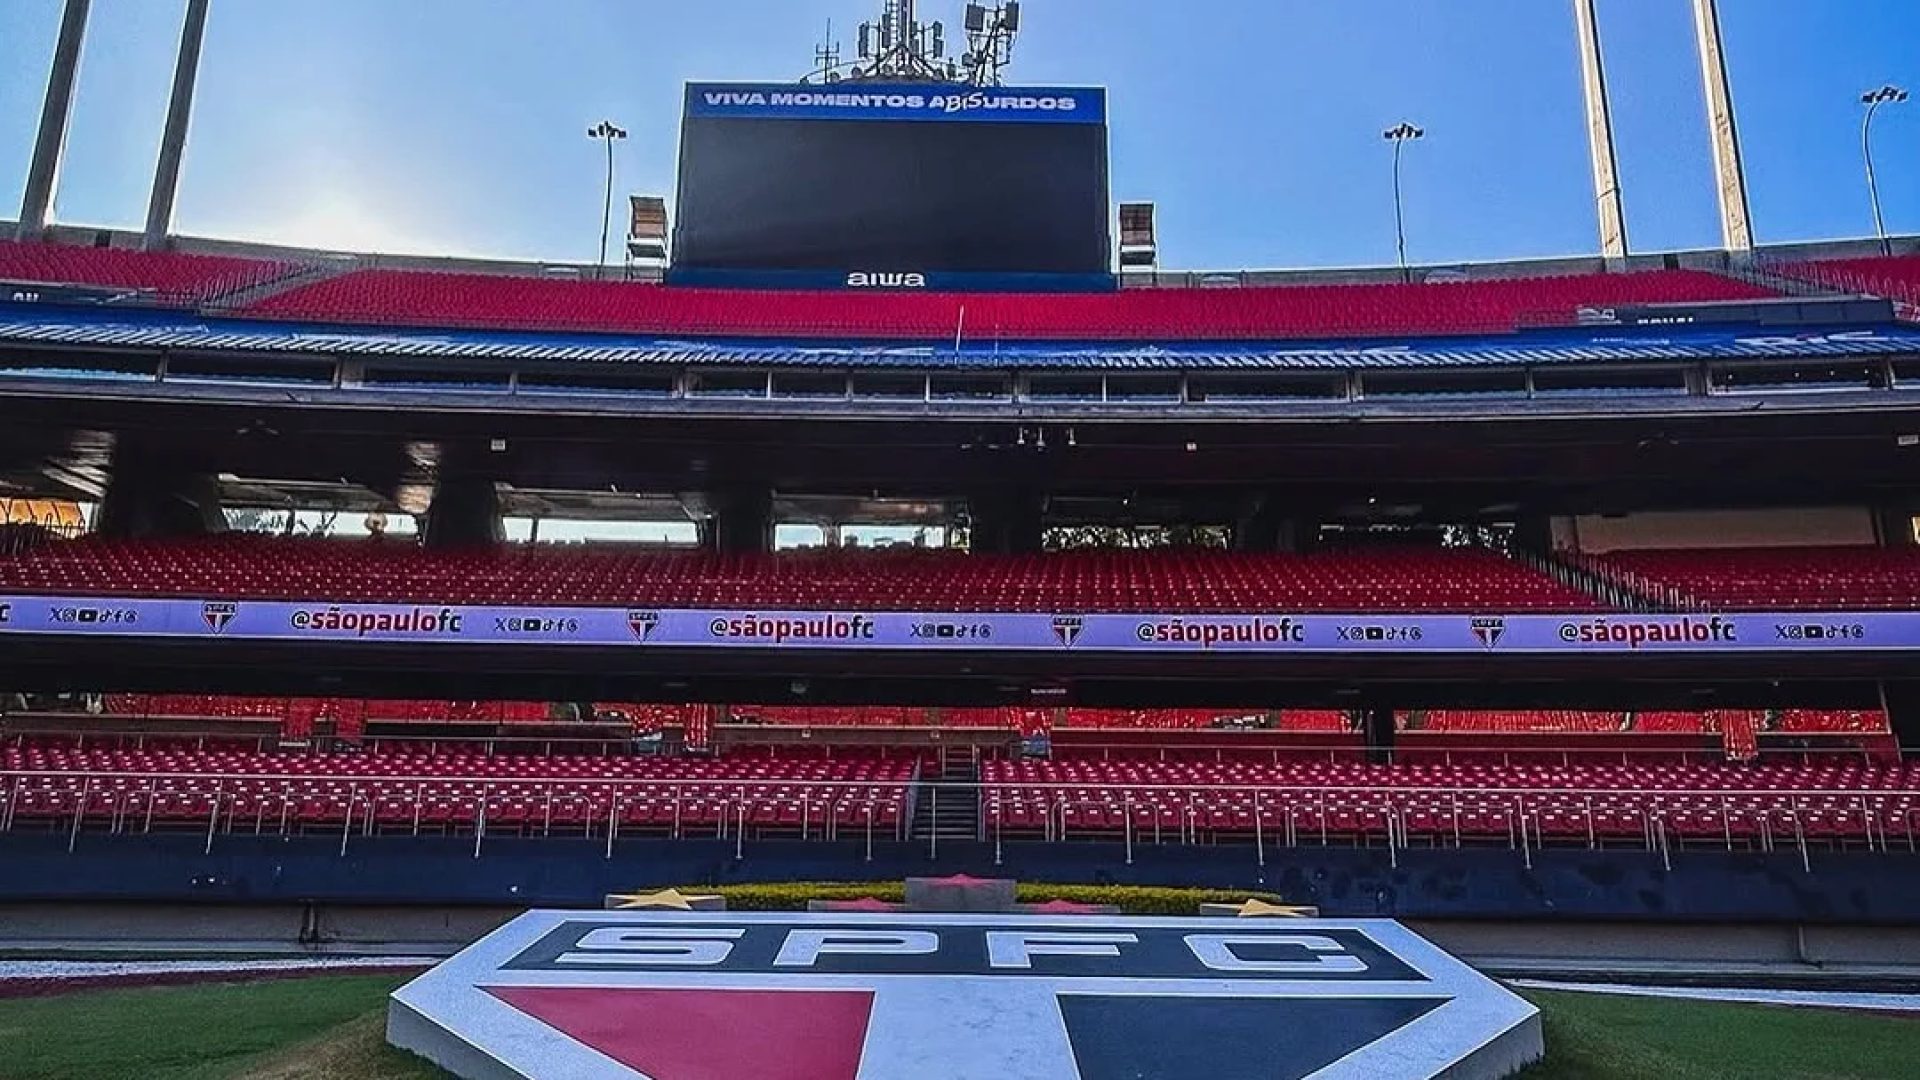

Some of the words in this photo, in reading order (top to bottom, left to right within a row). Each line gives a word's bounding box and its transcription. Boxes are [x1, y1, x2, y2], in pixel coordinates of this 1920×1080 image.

[704, 93, 766, 106] VIVA
[771, 93, 924, 108] MOMENTOS
[847, 272, 925, 287] aiwa
[291, 606, 462, 637] @sãopaulofc
[710, 614, 874, 643] @sãopaulofc
[1137, 617, 1304, 647] @sãopaulofc
[1559, 616, 1736, 648] @sãopaulofc
[554, 926, 1370, 973] SPFC
